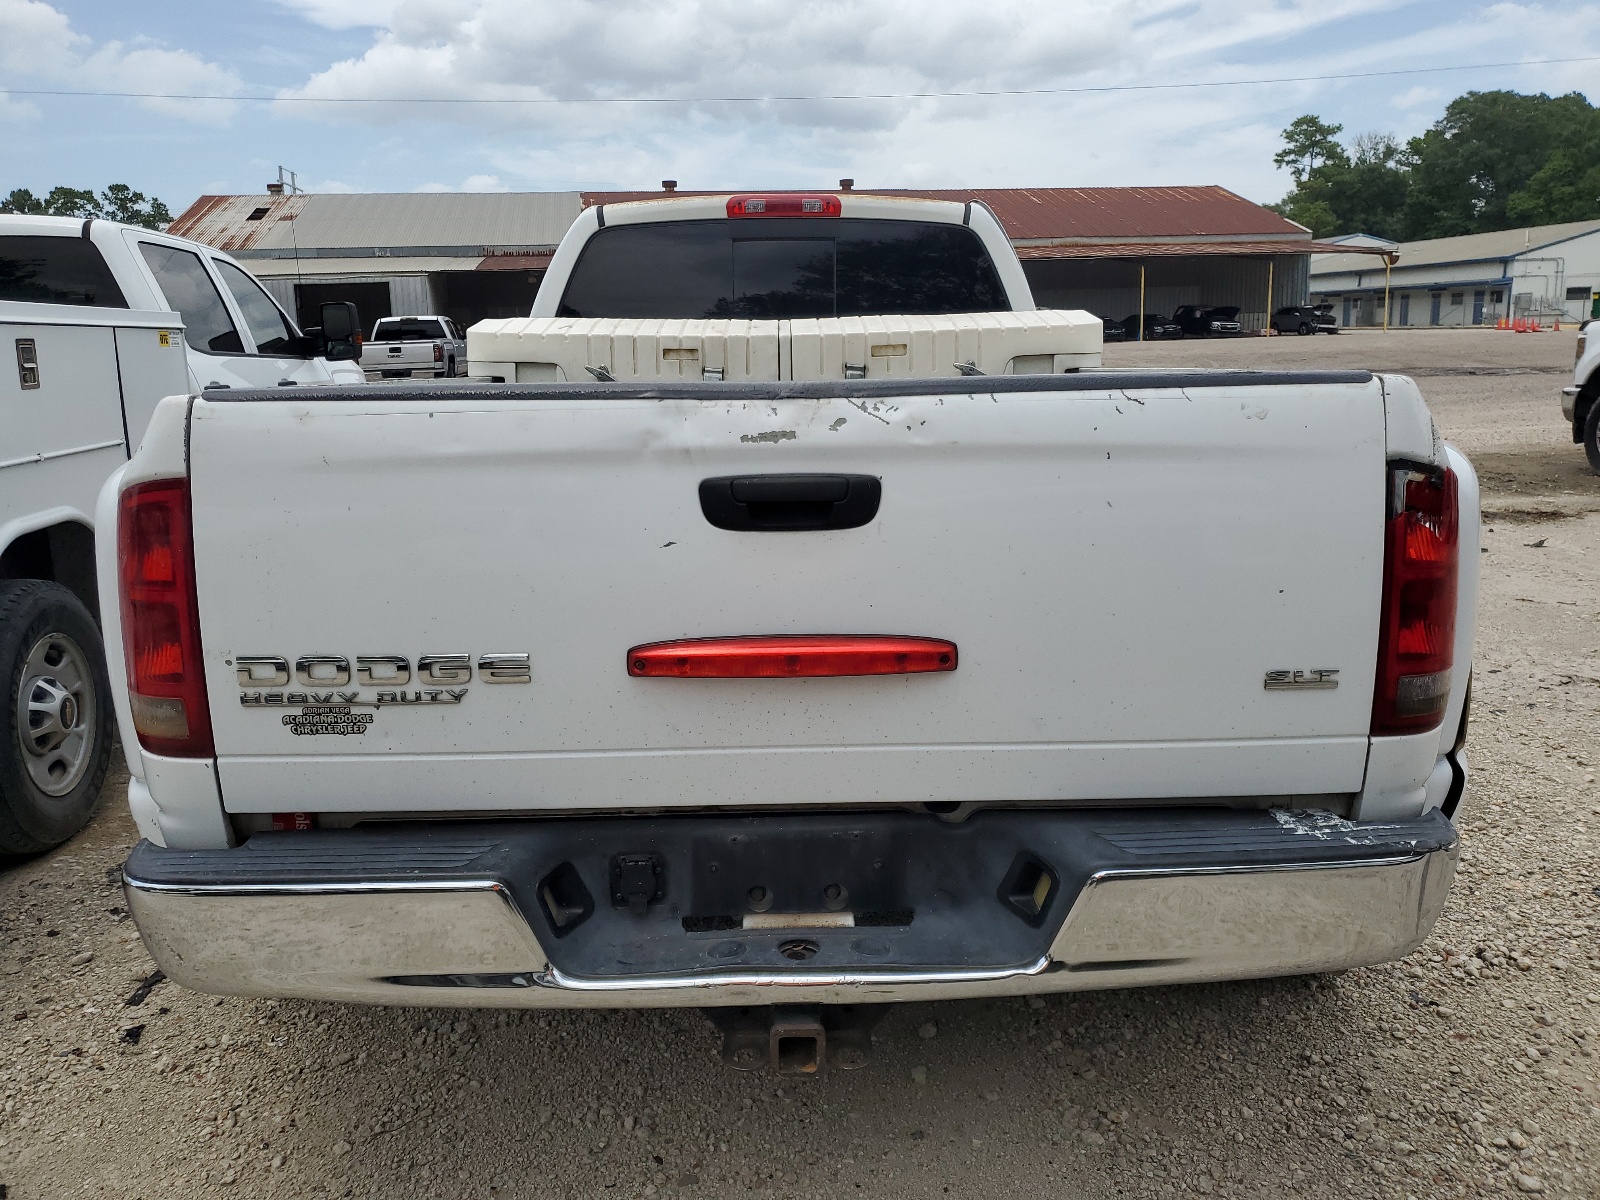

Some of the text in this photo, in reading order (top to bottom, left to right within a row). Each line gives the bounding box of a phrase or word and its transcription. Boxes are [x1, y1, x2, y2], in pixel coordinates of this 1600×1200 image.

[236, 653, 531, 687] DODGE
[239, 689, 468, 706] HEAVY DUTY
[282, 714, 373, 724] ACADIANA DODGE
[291, 725, 367, 735] CHRYSLER JEEP
